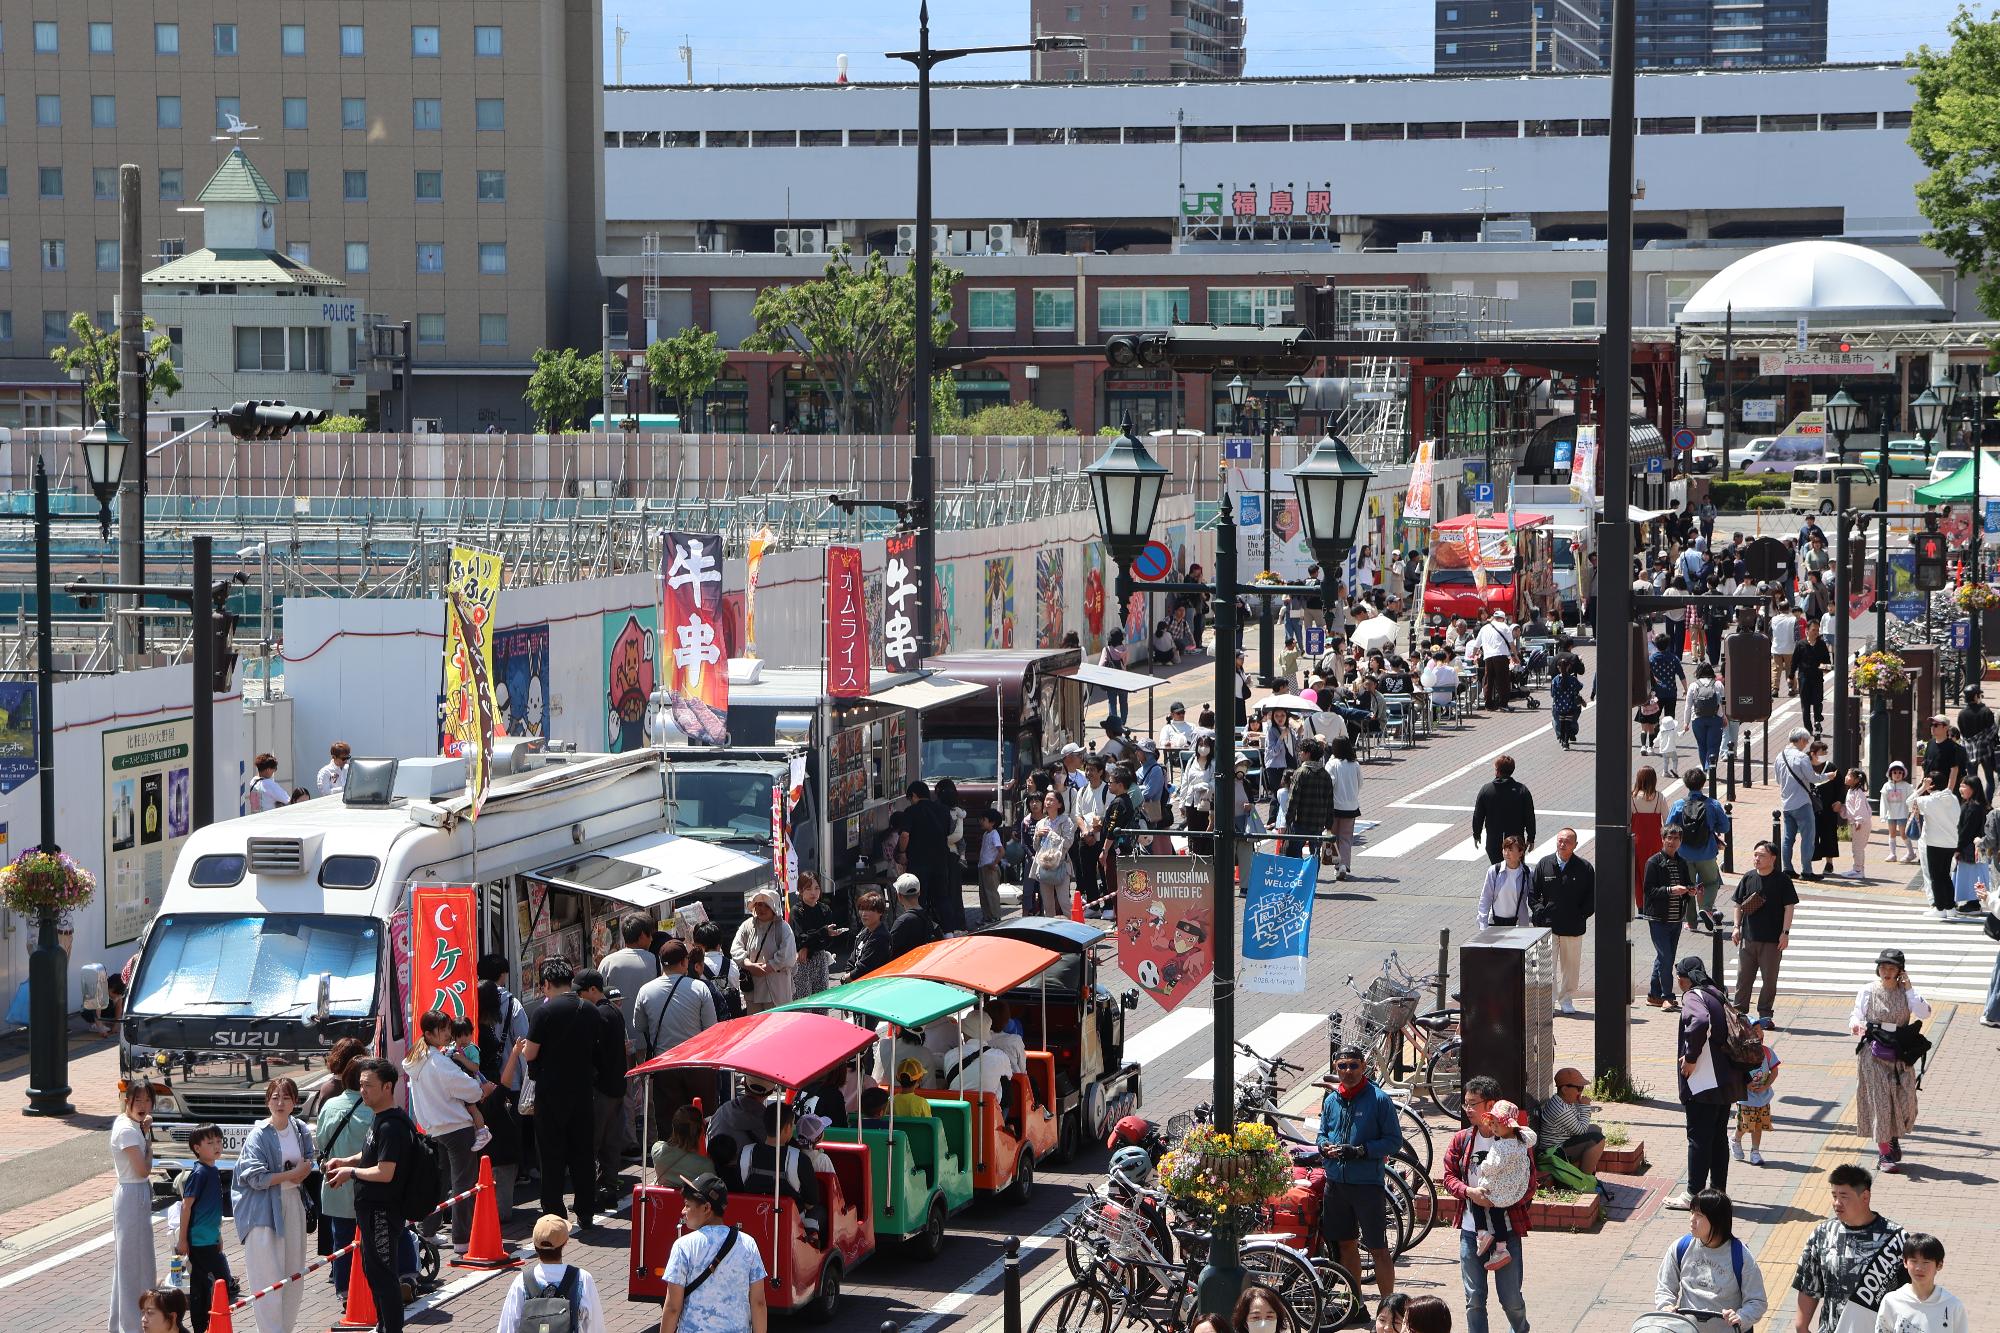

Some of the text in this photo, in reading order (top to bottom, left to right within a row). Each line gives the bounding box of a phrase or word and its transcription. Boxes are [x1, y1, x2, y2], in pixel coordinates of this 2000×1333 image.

[1182, 191, 1331, 216] JR 福島駅
[323, 304, 355, 322] POLICE
[1234, 444, 1241, 458] 1
[1650, 458, 1660, 471] P
[1479, 485, 1491, 500] P
[1247, 549, 1265, 557] Cultu
[668, 538, 722, 688] 牛串
[885, 558, 918, 668] 牛串
[839, 571, 857, 687] オムライス
[1156, 871, 1209, 884] FUKUSHIMA
[1264, 878, 1303, 888] WELCOE
[1157, 886, 1202, 898] UNITED FC
[430, 937, 467, 1017] ケバ
[209, 1031, 280, 1046] SUZU
